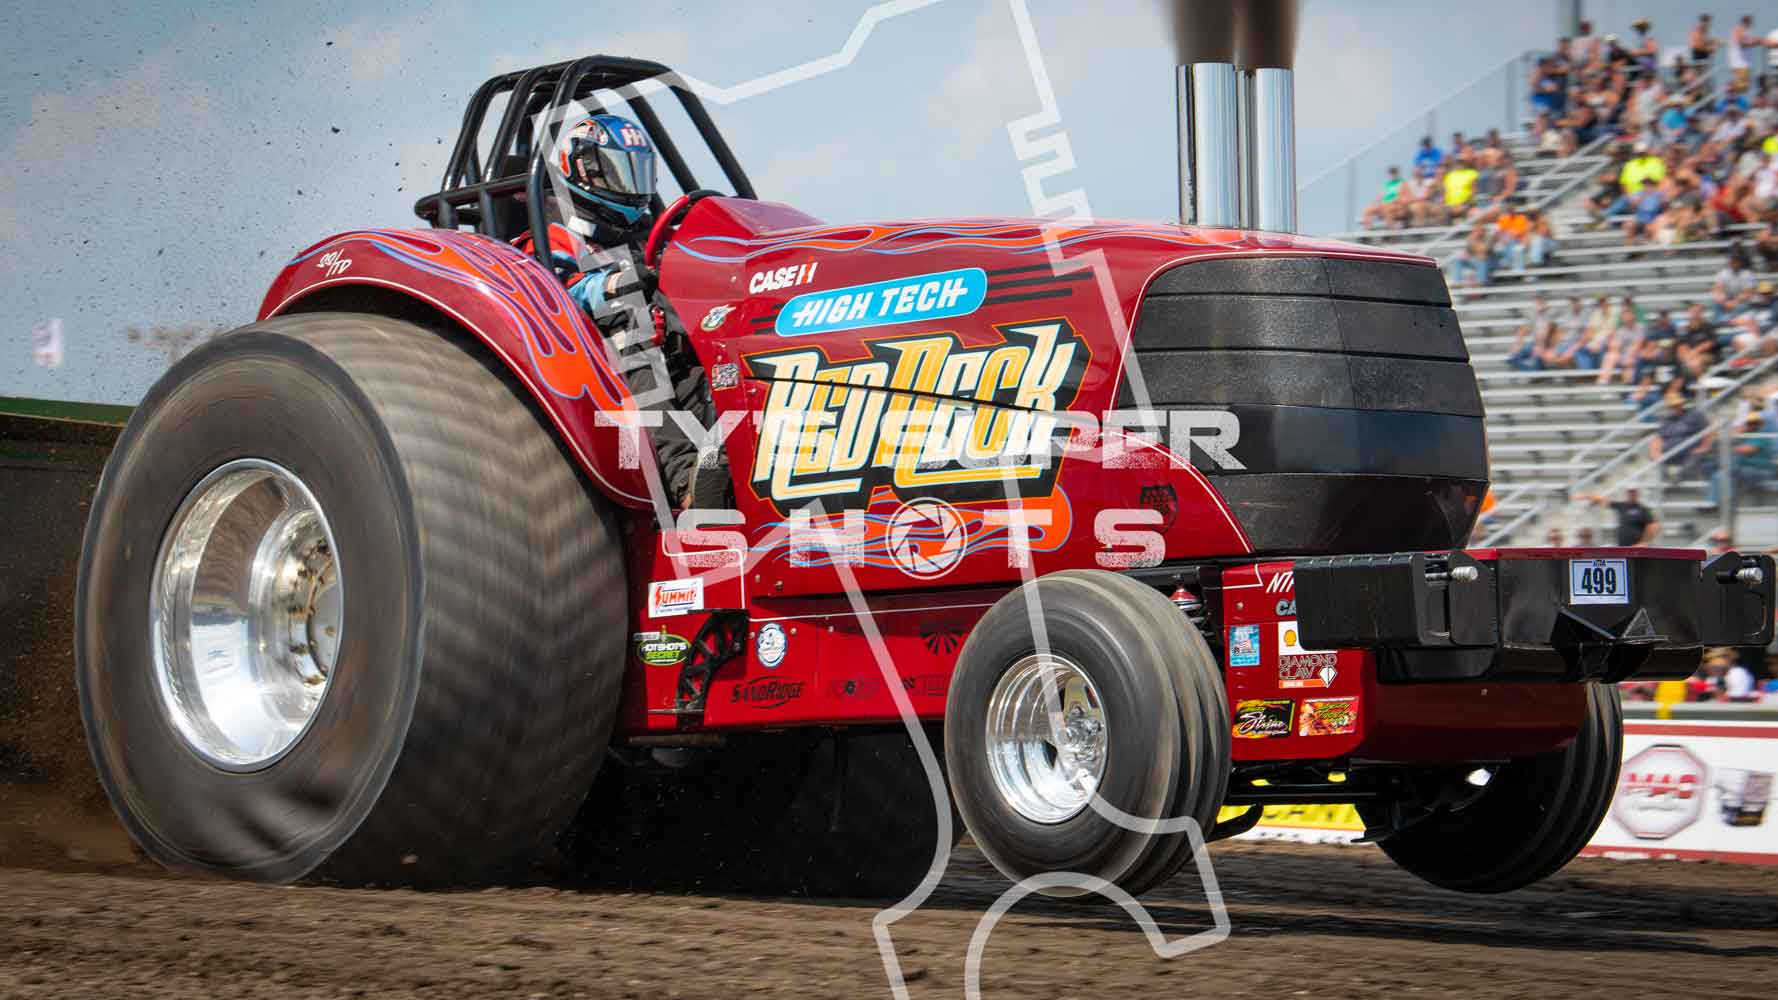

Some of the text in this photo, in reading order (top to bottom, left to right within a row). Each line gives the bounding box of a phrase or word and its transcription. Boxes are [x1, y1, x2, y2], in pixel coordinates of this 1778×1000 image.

[792, 277, 968, 328] HIGH TECH
[1581, 567, 1617, 594] 499
[1280, 654, 1338, 668] DIAMOND
[1280, 666, 1315, 680] CLAW
